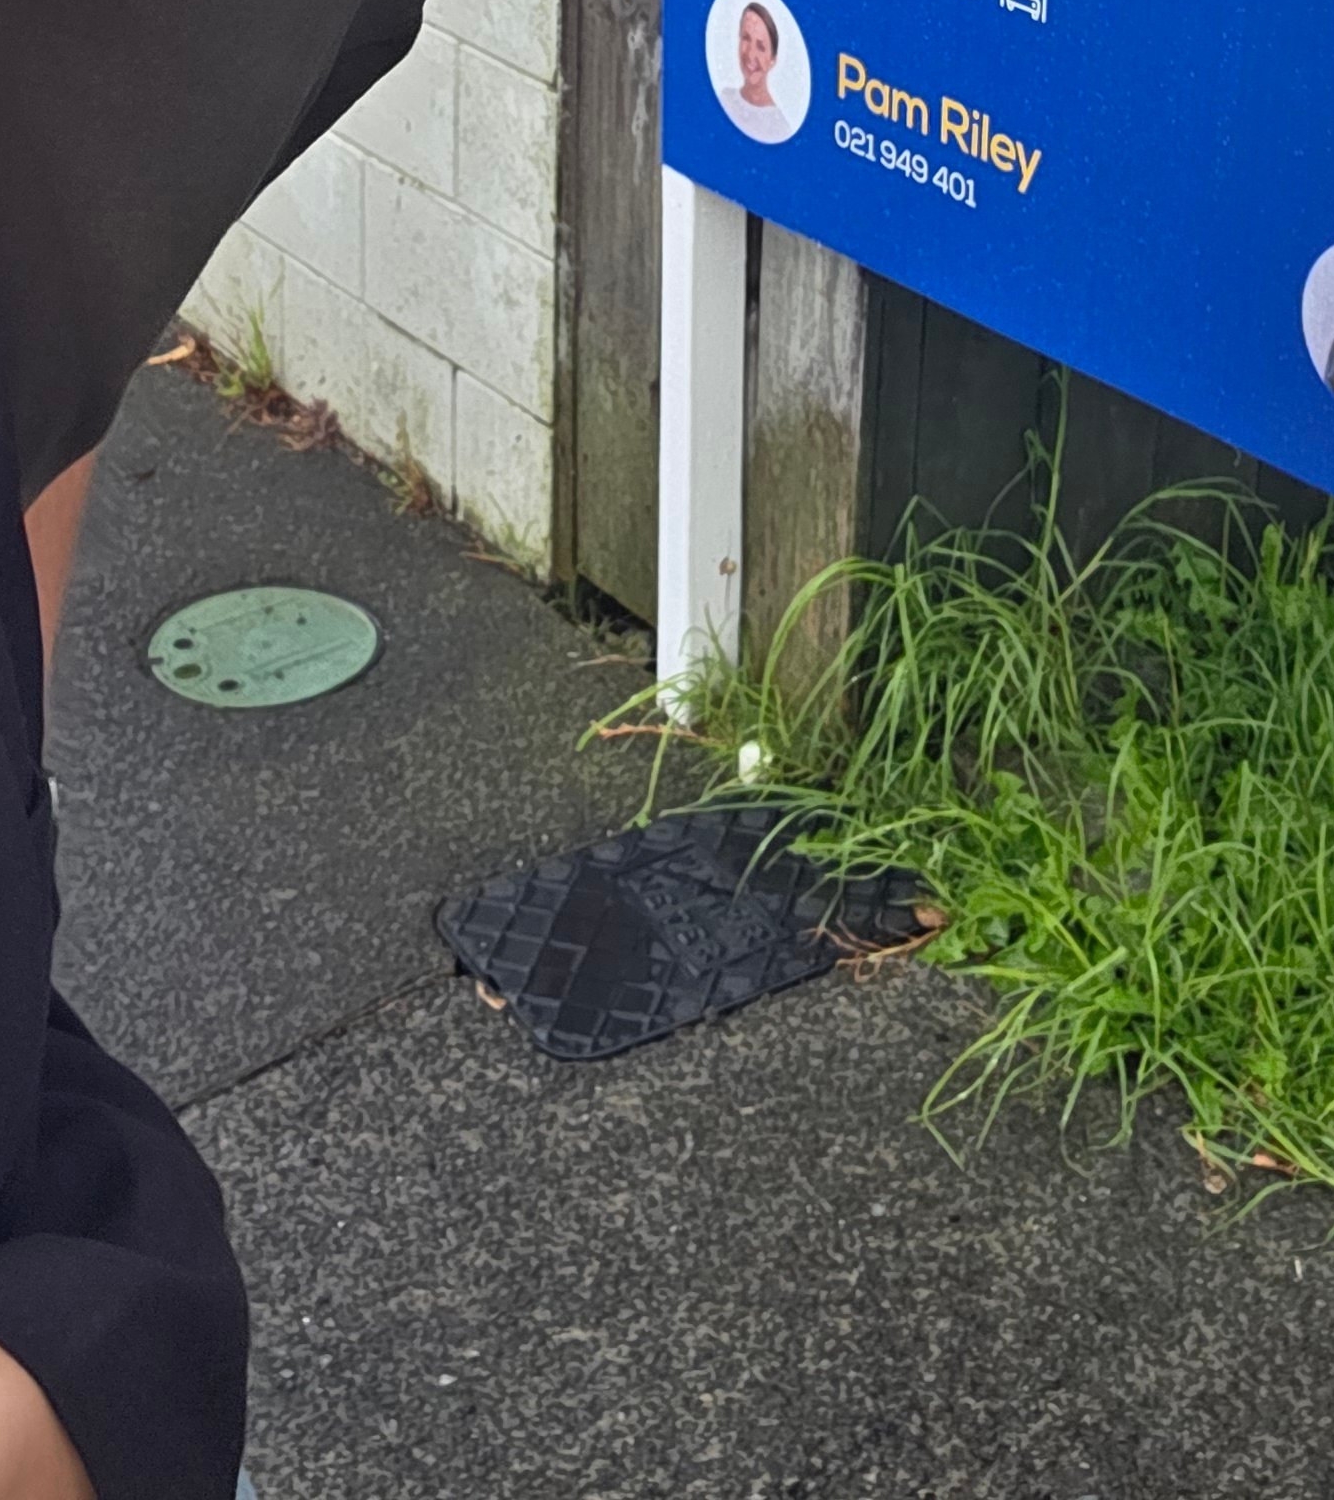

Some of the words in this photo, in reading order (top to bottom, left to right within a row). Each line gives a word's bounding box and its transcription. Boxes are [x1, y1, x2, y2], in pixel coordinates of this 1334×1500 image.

[834, 119, 876, 164] 021
[879, 144, 929, 184] 949
[933, 164, 977, 209] 401
[837, 52, 929, 136] Pam
[940, 96, 1042, 194] Riley
